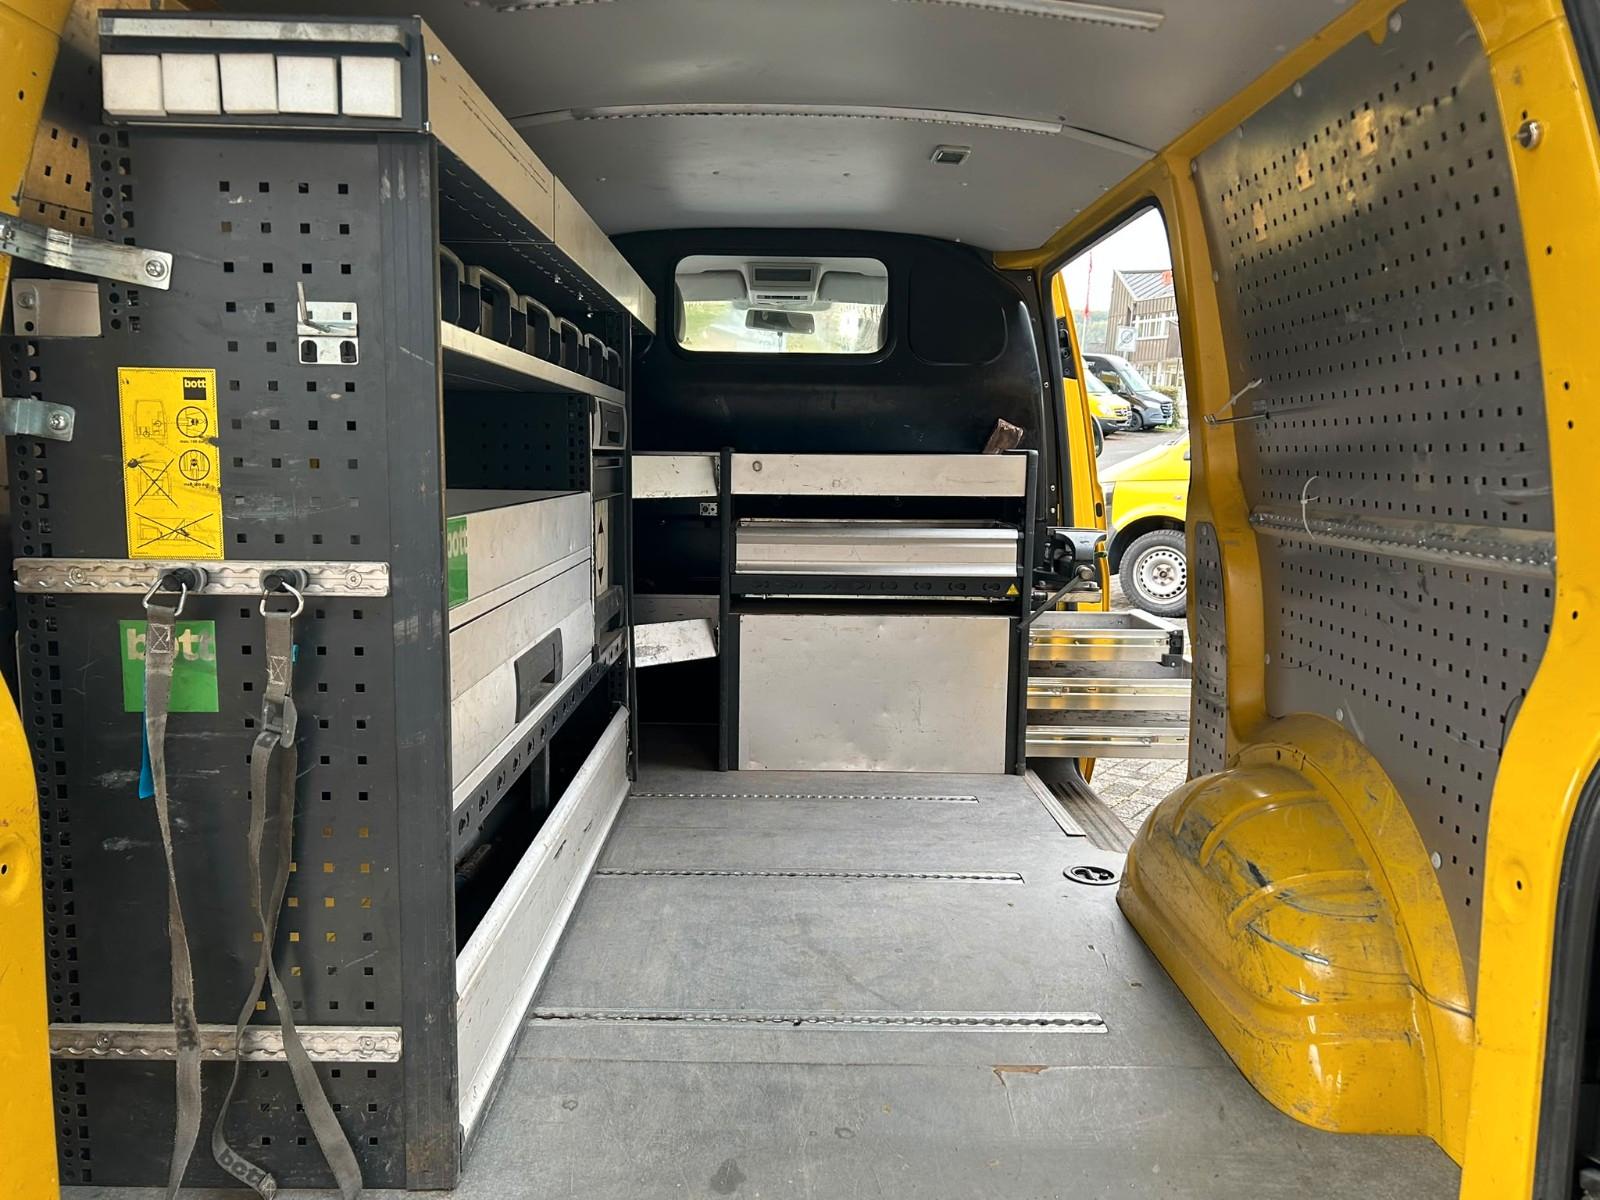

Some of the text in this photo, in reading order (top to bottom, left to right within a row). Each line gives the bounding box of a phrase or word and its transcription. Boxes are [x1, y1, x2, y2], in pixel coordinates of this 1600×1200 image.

[183, 379, 207, 388] bott
[126, 628, 217, 661] btt
[218, 1148, 265, 1184] bot
